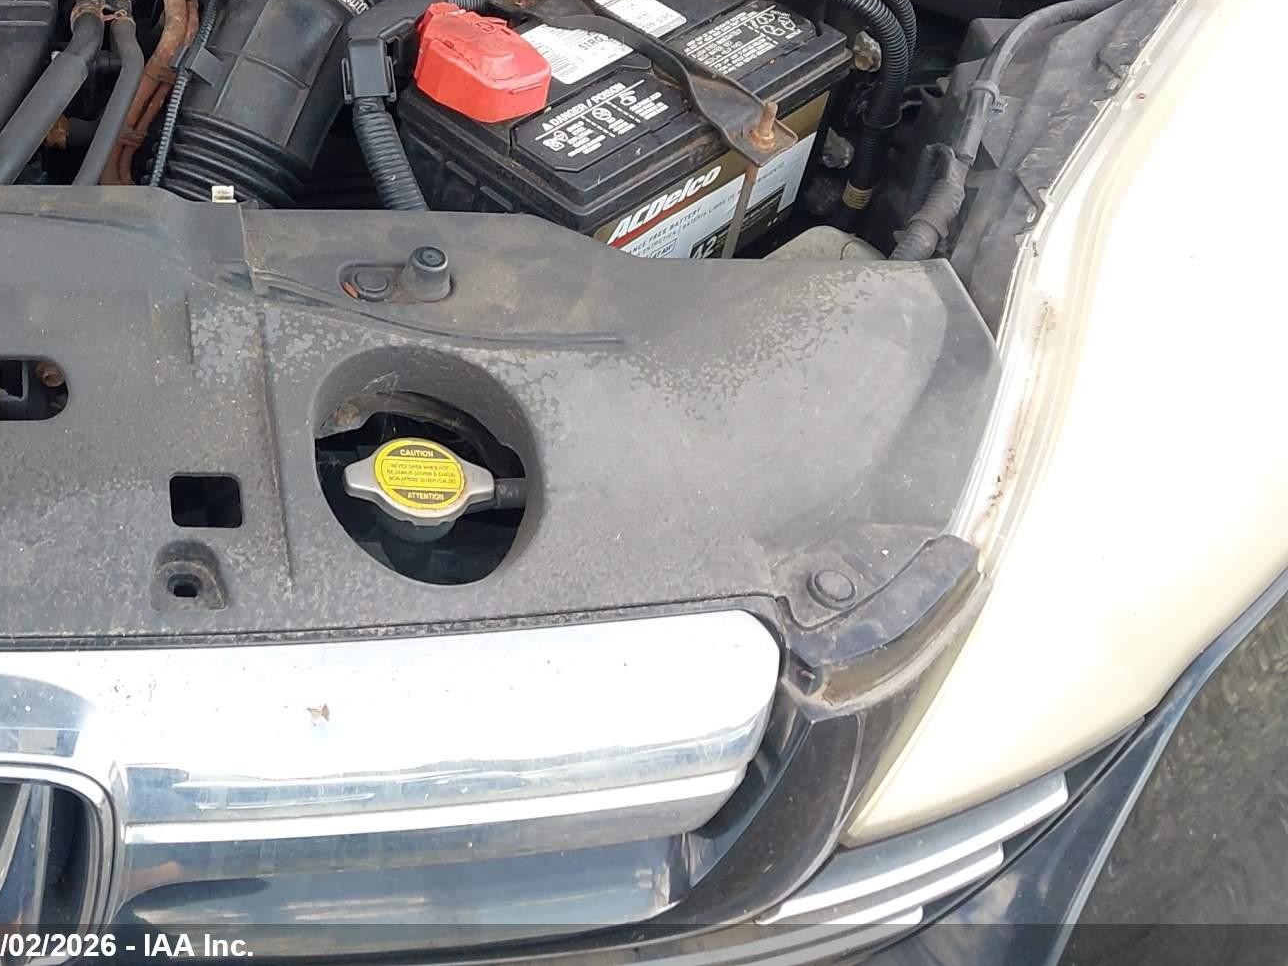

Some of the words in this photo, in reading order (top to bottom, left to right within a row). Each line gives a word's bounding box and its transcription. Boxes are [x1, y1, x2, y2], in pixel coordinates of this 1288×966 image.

[549, 103, 588, 126] DANGER
[591, 82, 626, 104] POISON
[606, 165, 722, 246] ACDelco
[399, 449, 434, 458] CAUTION
[407, 491, 445, 501] ATTENTION
